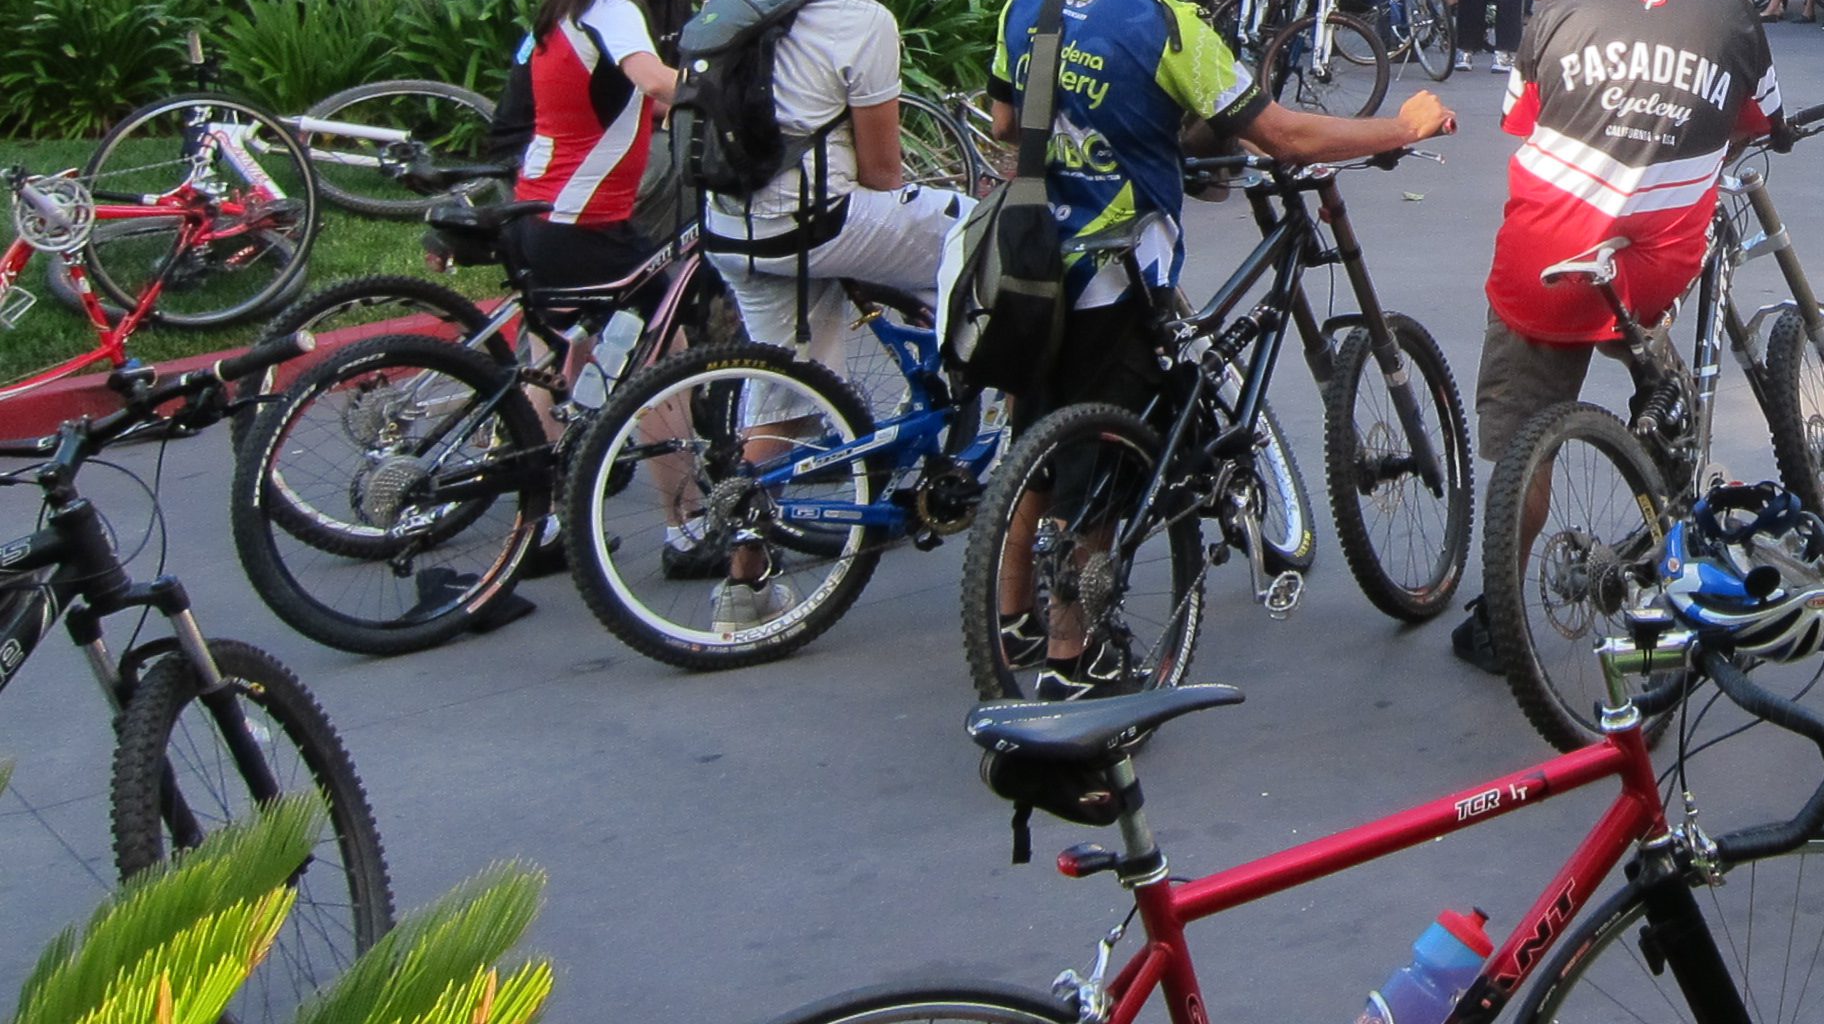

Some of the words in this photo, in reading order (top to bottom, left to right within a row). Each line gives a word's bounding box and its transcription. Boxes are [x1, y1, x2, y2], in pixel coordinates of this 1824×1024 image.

[1560, 41, 1731, 111] PASADENA
[1601, 86, 1693, 126] Cyclery
[1605, 125, 1653, 142] CALIFORNIA
[706, 358, 768, 371] MAXXIS
[1455, 788, 1500, 821] TCR
